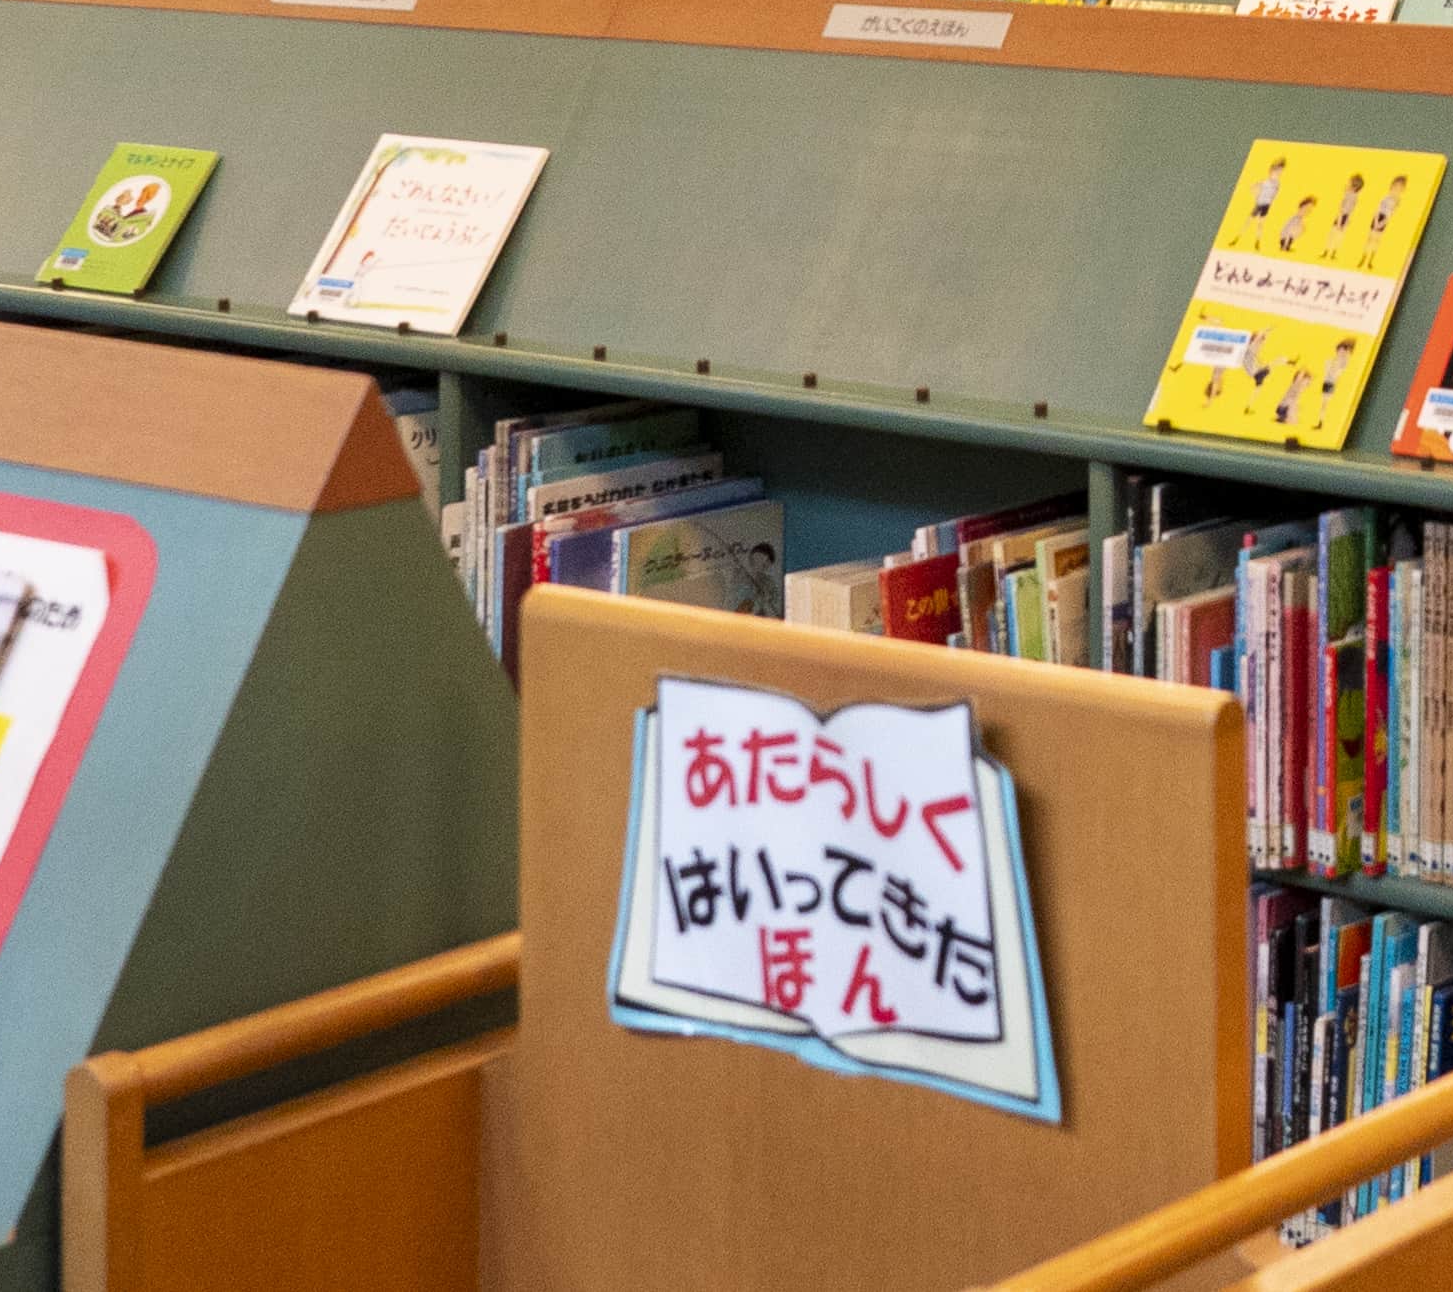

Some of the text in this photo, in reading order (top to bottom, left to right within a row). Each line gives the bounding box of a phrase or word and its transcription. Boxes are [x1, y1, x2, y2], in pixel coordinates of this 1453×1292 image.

[859, 16, 971, 39] がいこくのえほん
[683, 726, 973, 874] あたらしく
[664, 843, 995, 1006] はいってきた
[758, 924, 899, 1026] ほん
